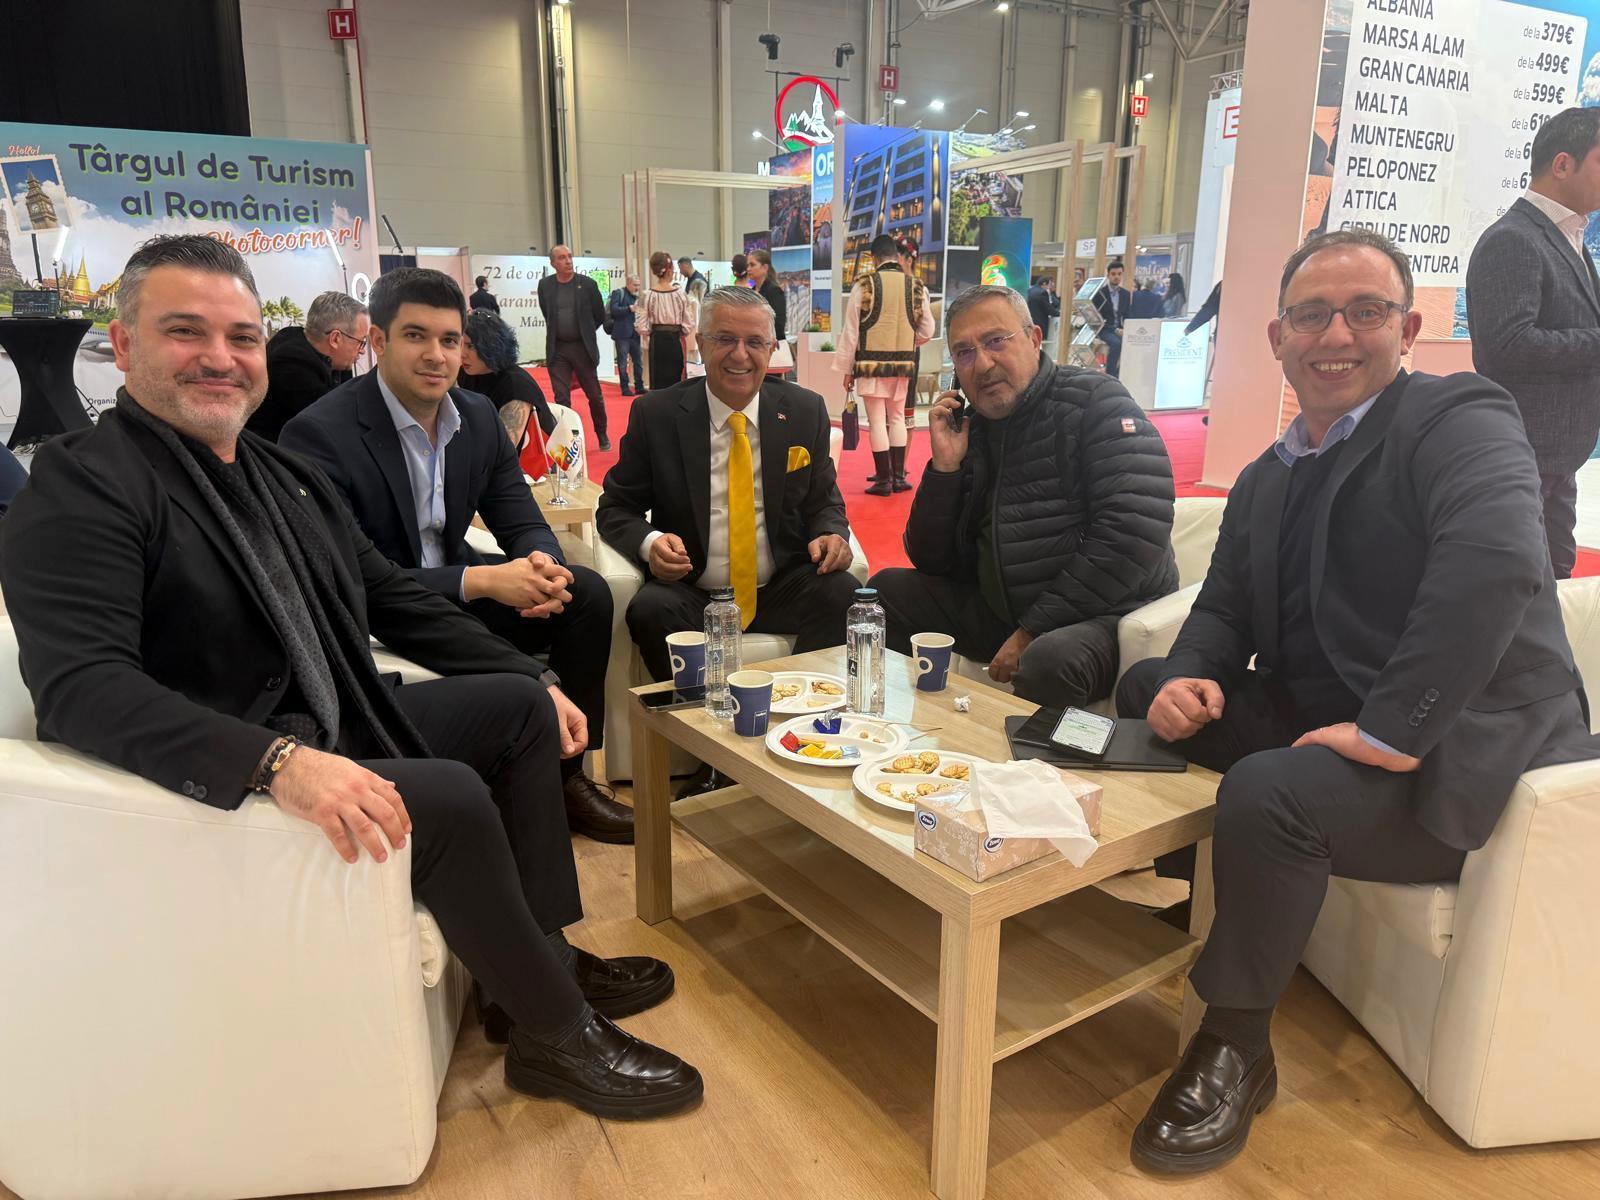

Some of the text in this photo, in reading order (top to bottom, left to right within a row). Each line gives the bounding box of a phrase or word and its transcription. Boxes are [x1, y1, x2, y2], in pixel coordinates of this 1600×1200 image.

[335, 15, 351, 34] H
[1523, 21, 1575, 44] de la 379€
[1362, 22, 1465, 59] MARSA ALAM
[1359, 56, 1470, 92] GRAN CANARIA
[1517, 52, 1570, 75] de la 499€
[883, 70, 895, 88] H
[1354, 90, 1409, 117] MALTA
[1513, 82, 1566, 105] de la 599€
[1134, 99, 1145, 114] H
[1511, 117, 1521, 130] de
[1522, 118, 1529, 131] la
[1350, 123, 1455, 153] MUNTENEGRU
[1504, 146, 1514, 159] de
[1514, 148, 1522, 160] la
[68, 142, 356, 189] Târgul de Turism
[1346, 156, 1438, 183] PELOPONEZ
[1501, 177, 1511, 189] de
[1511, 178, 1518, 190] la
[120, 190, 321, 225] al României
[1342, 189, 1397, 211] ATTICA
[1388, 222, 1408, 243] DE
[1410, 223, 1451, 244] NORD
[483, 266, 502, 279] 72
[506, 266, 522, 280] de
[519, 316, 546, 328] Mân
[87, 397, 117, 406] Organiz
